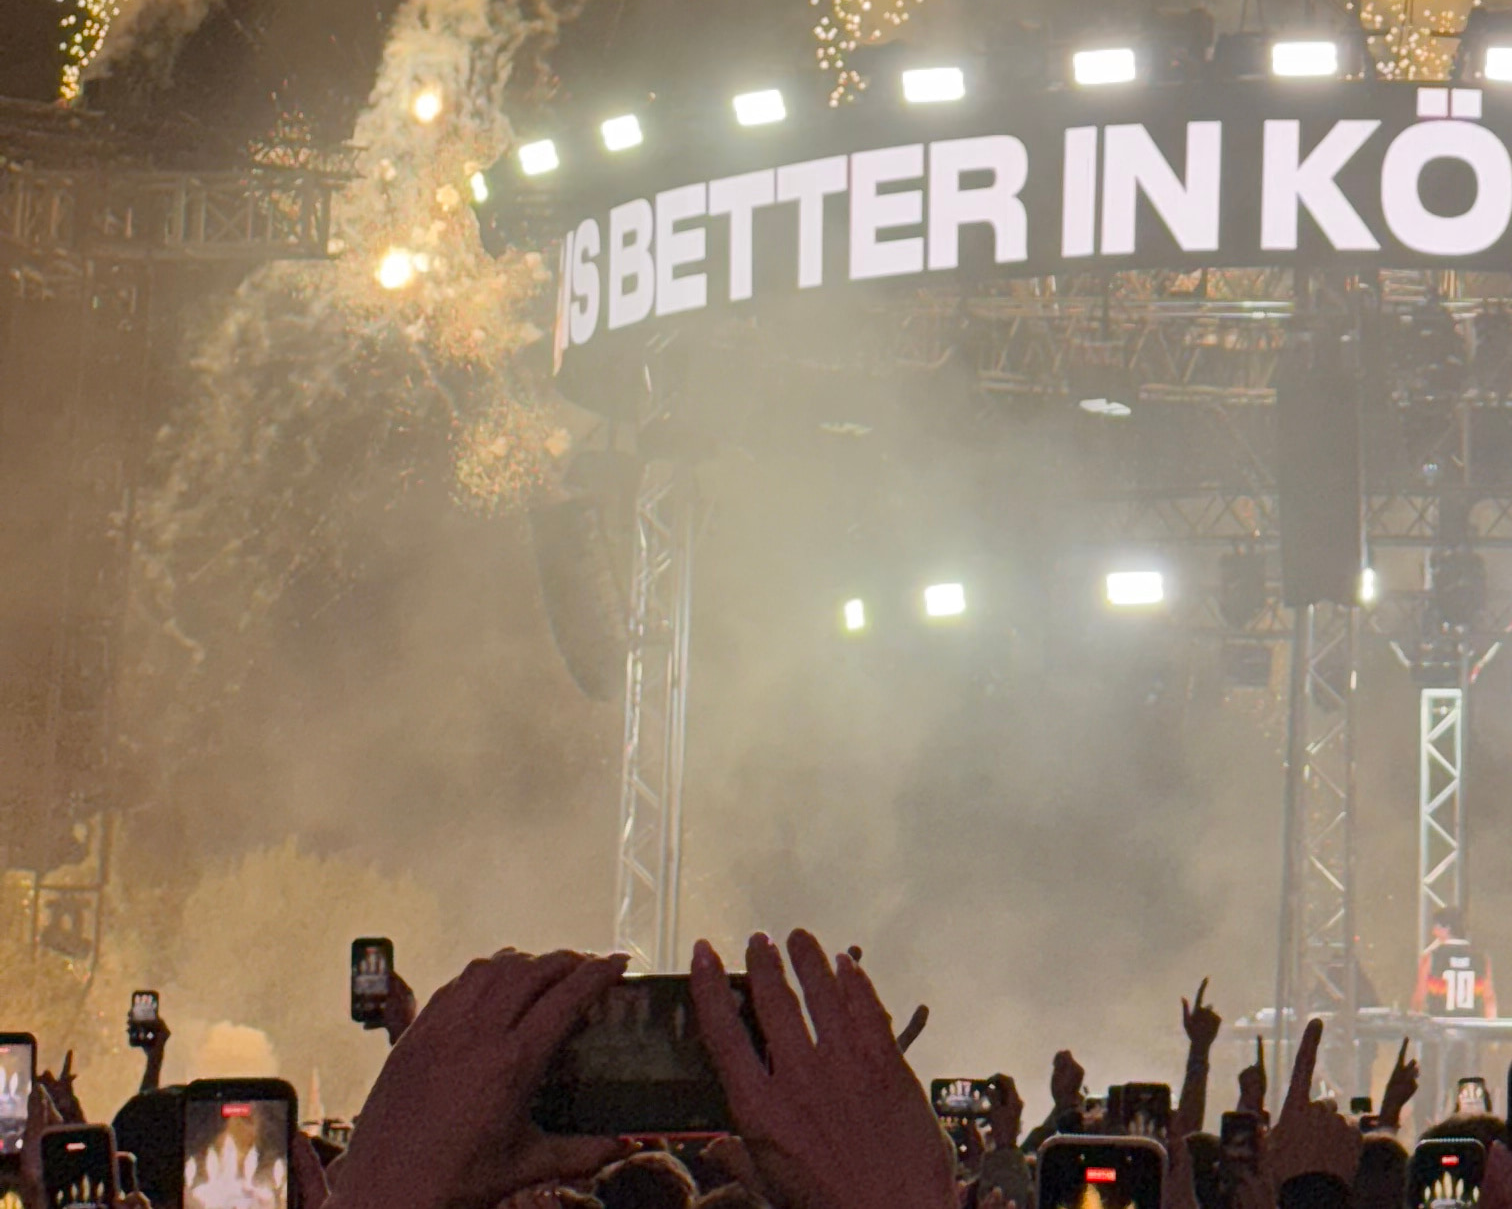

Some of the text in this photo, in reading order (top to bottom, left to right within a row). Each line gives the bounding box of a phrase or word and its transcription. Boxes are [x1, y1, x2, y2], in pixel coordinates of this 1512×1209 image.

[559, 218, 600, 351] IS
[608, 135, 1028, 330] BETTER
[1061, 120, 1222, 258] IN
[1442, 969, 1475, 1011] 10
